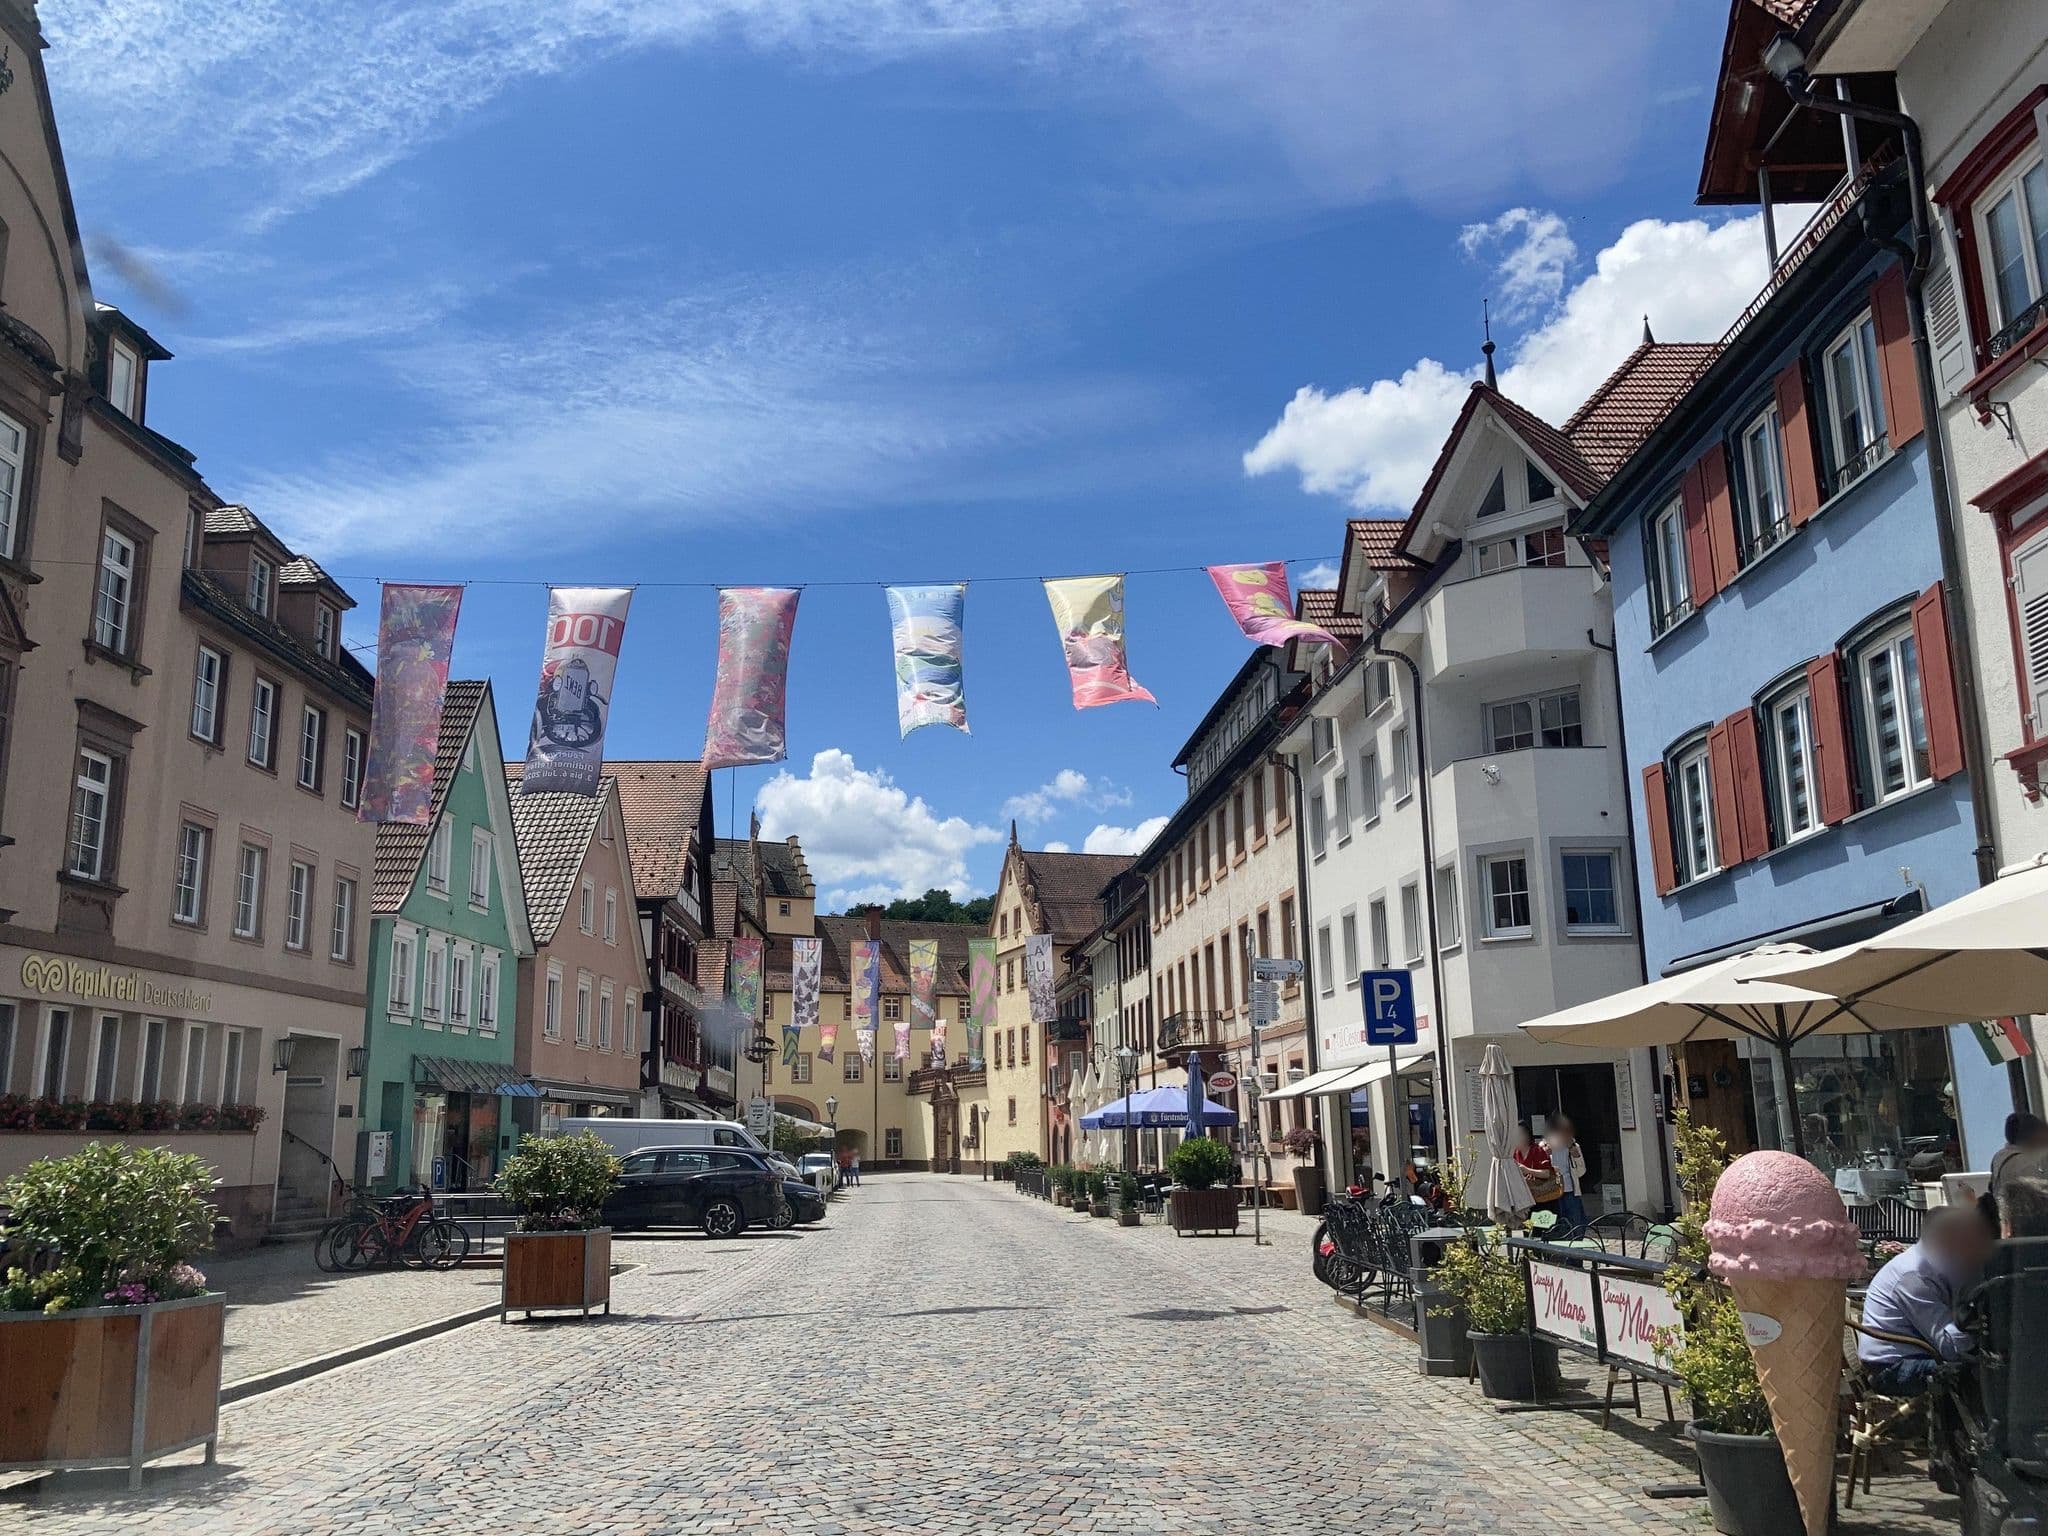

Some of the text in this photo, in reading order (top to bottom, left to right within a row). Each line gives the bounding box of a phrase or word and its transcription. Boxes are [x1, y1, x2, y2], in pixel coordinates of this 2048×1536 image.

[143, 981, 214, 1012] Deutschland
[1373, 979, 1401, 1019] P
[1161, 1112, 1190, 1121] Fürstenber
[435, 1164, 442, 1182] P
[1545, 1277, 1586, 1323] Milano
